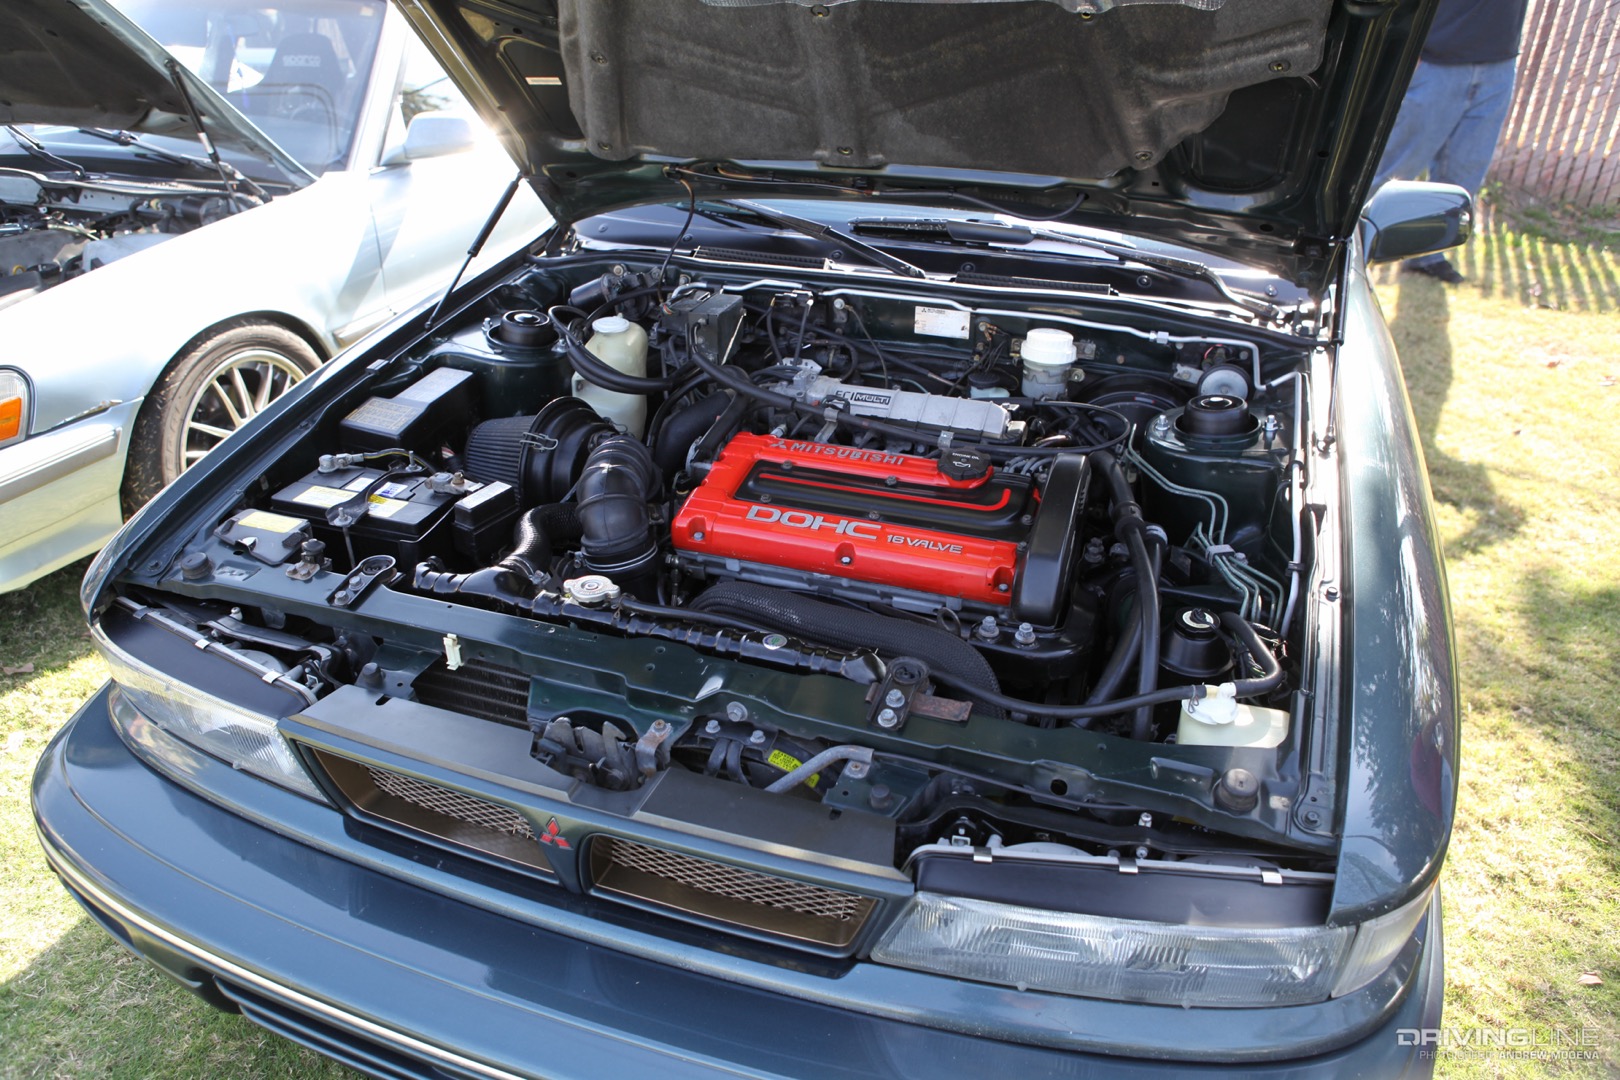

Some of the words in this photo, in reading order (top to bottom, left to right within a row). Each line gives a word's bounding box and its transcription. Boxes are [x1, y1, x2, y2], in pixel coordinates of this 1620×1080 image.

[855, 394, 890, 404] MULTI
[790, 442, 905, 465] MITSUBISHI
[746, 505, 882, 540] DOHC
